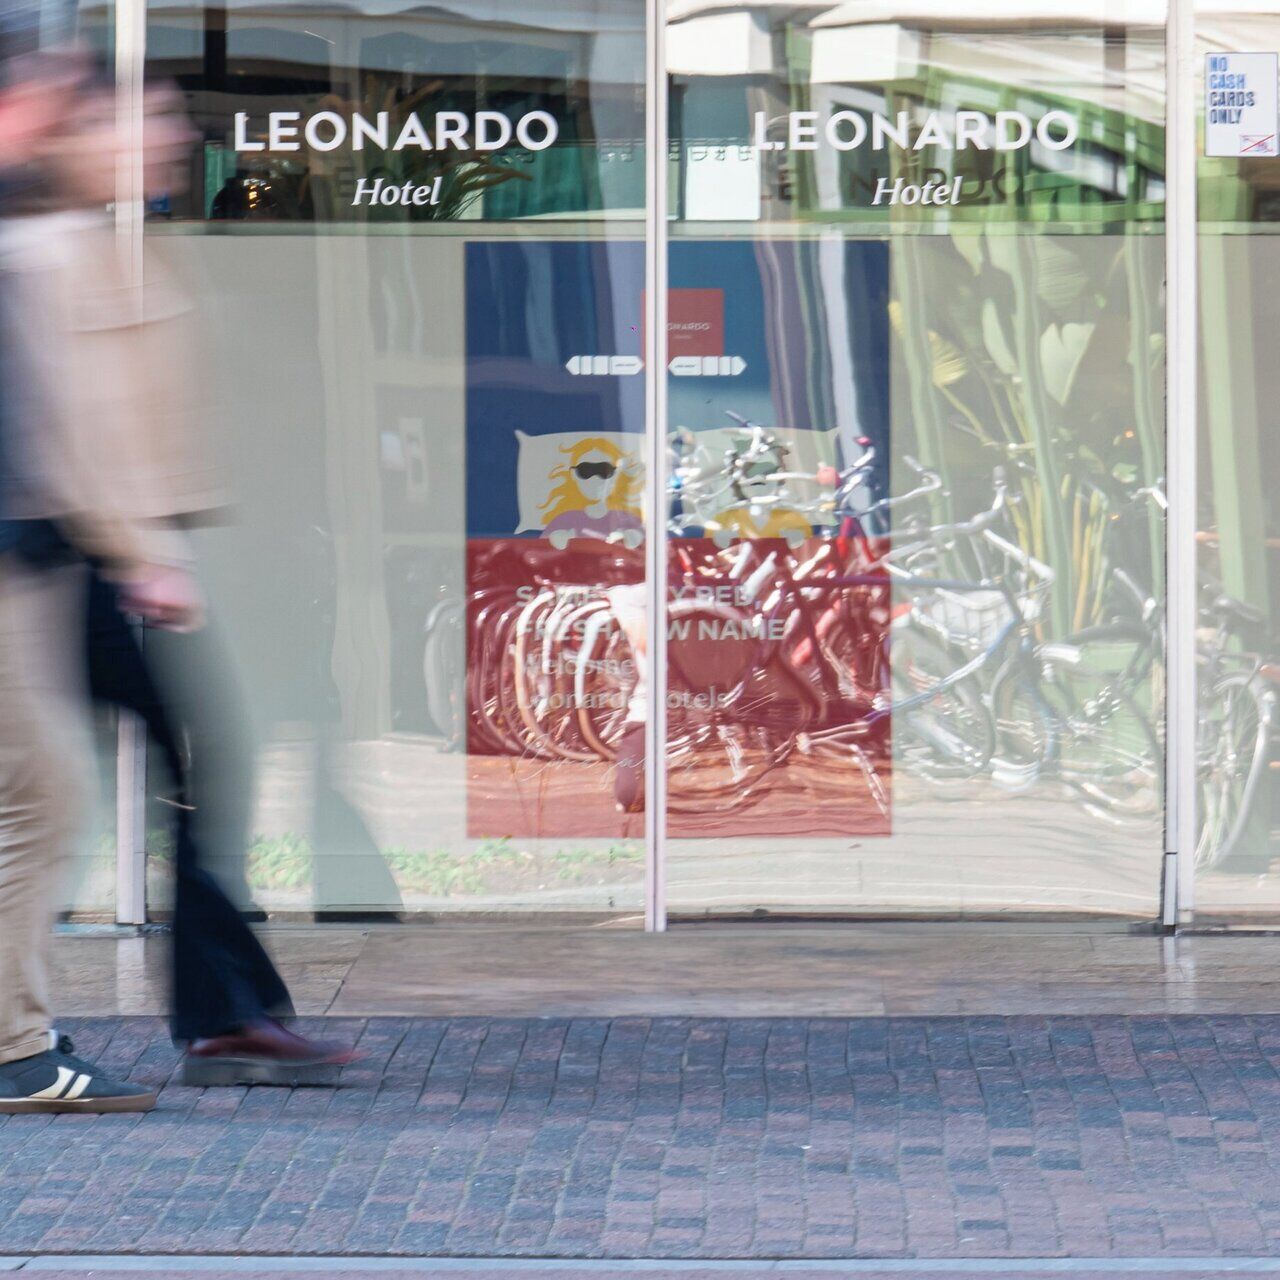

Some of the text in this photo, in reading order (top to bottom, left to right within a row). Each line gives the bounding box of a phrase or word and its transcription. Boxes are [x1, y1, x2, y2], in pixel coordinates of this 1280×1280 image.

[1210, 56, 1228, 72] NO
[1210, 73, 1246, 90] CASH
[1210, 91, 1256, 107] CARDS
[1210, 108, 1243, 124] ONLY
[234, 110, 559, 152] LEONARDO
[754, 110, 1080, 152] LEONARDO
[351, 176, 443, 207] Hotel
[871, 176, 963, 207] Hotel
[698, 619, 786, 640] NAME
